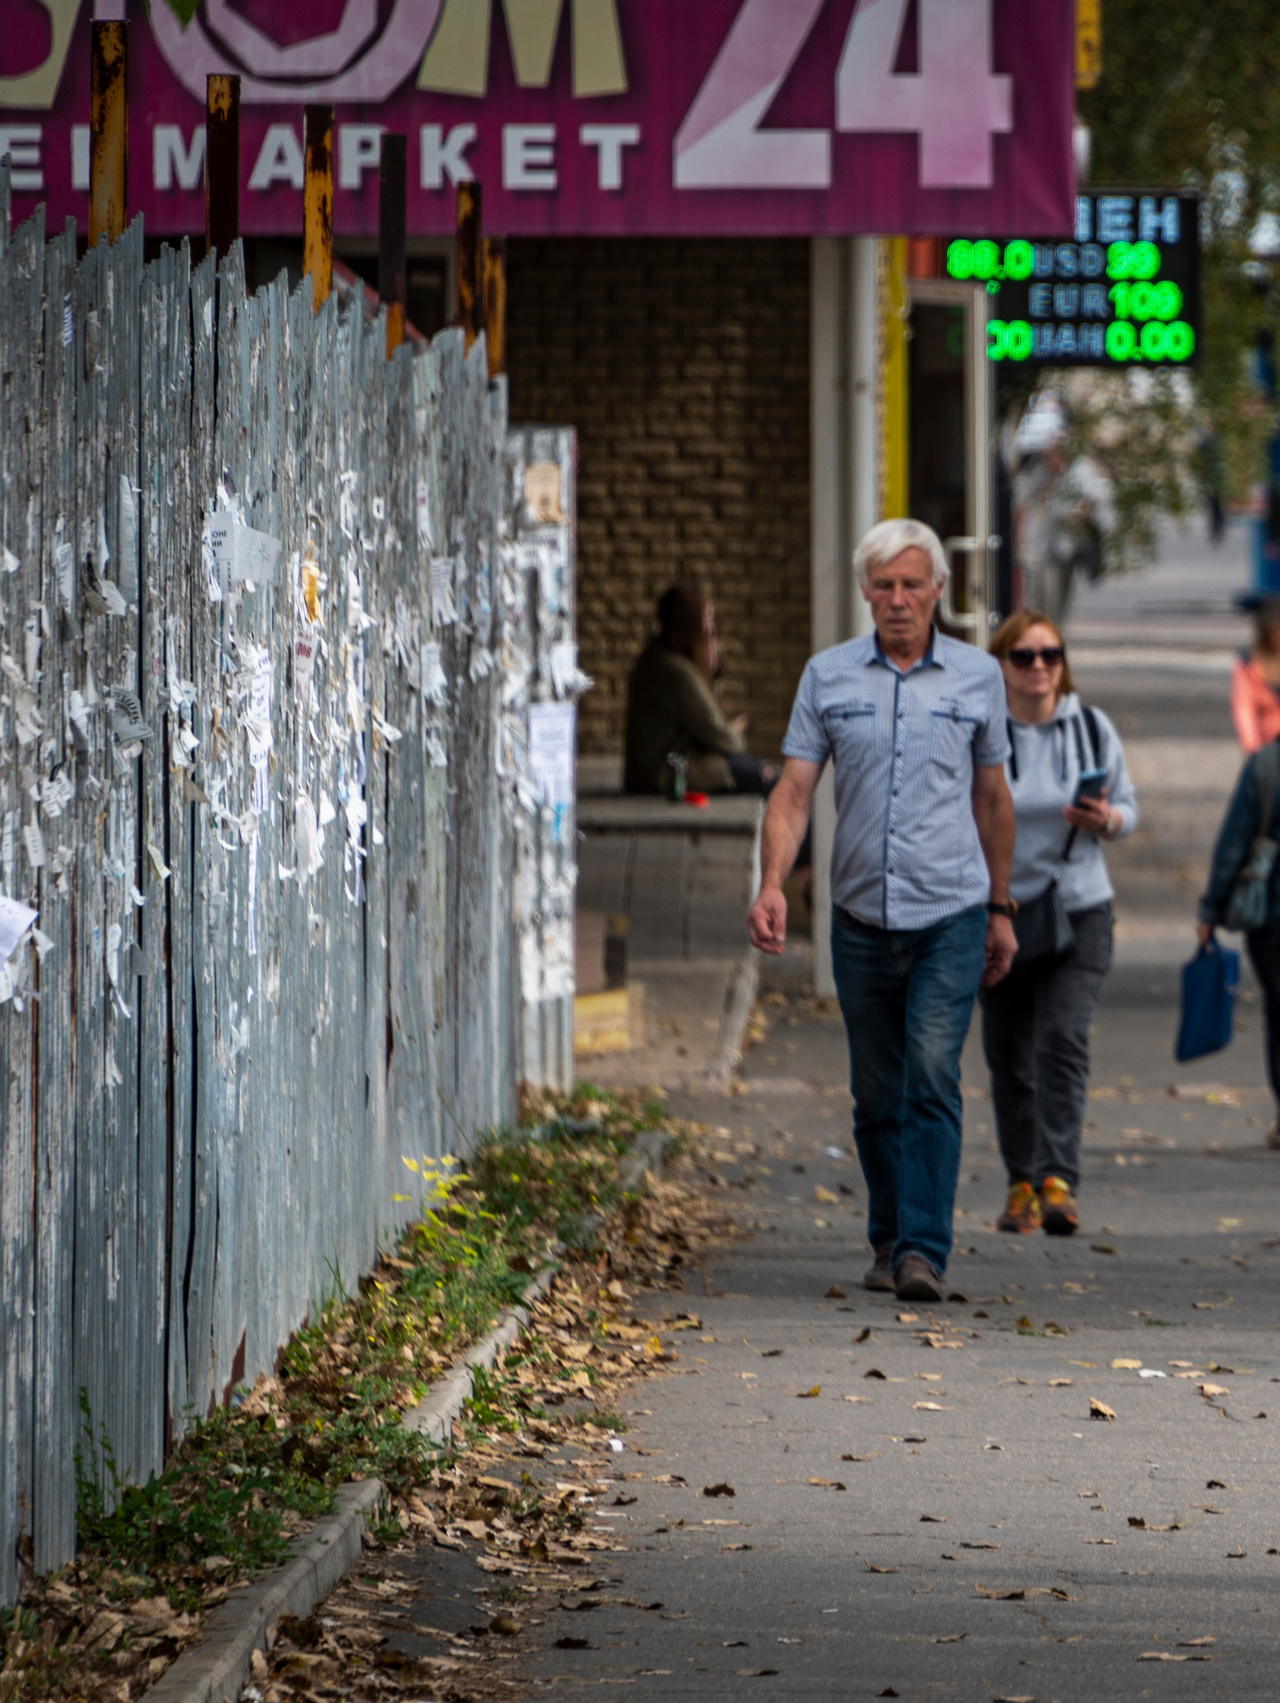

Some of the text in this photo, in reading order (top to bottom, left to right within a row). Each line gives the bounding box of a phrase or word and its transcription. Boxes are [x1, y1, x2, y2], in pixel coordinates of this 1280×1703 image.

[673, 0, 1013, 189] 24
[1034, 243, 1106, 278] USD
[1028, 282, 1112, 319] EUR
[1105, 320, 1196, 362] 0.00
